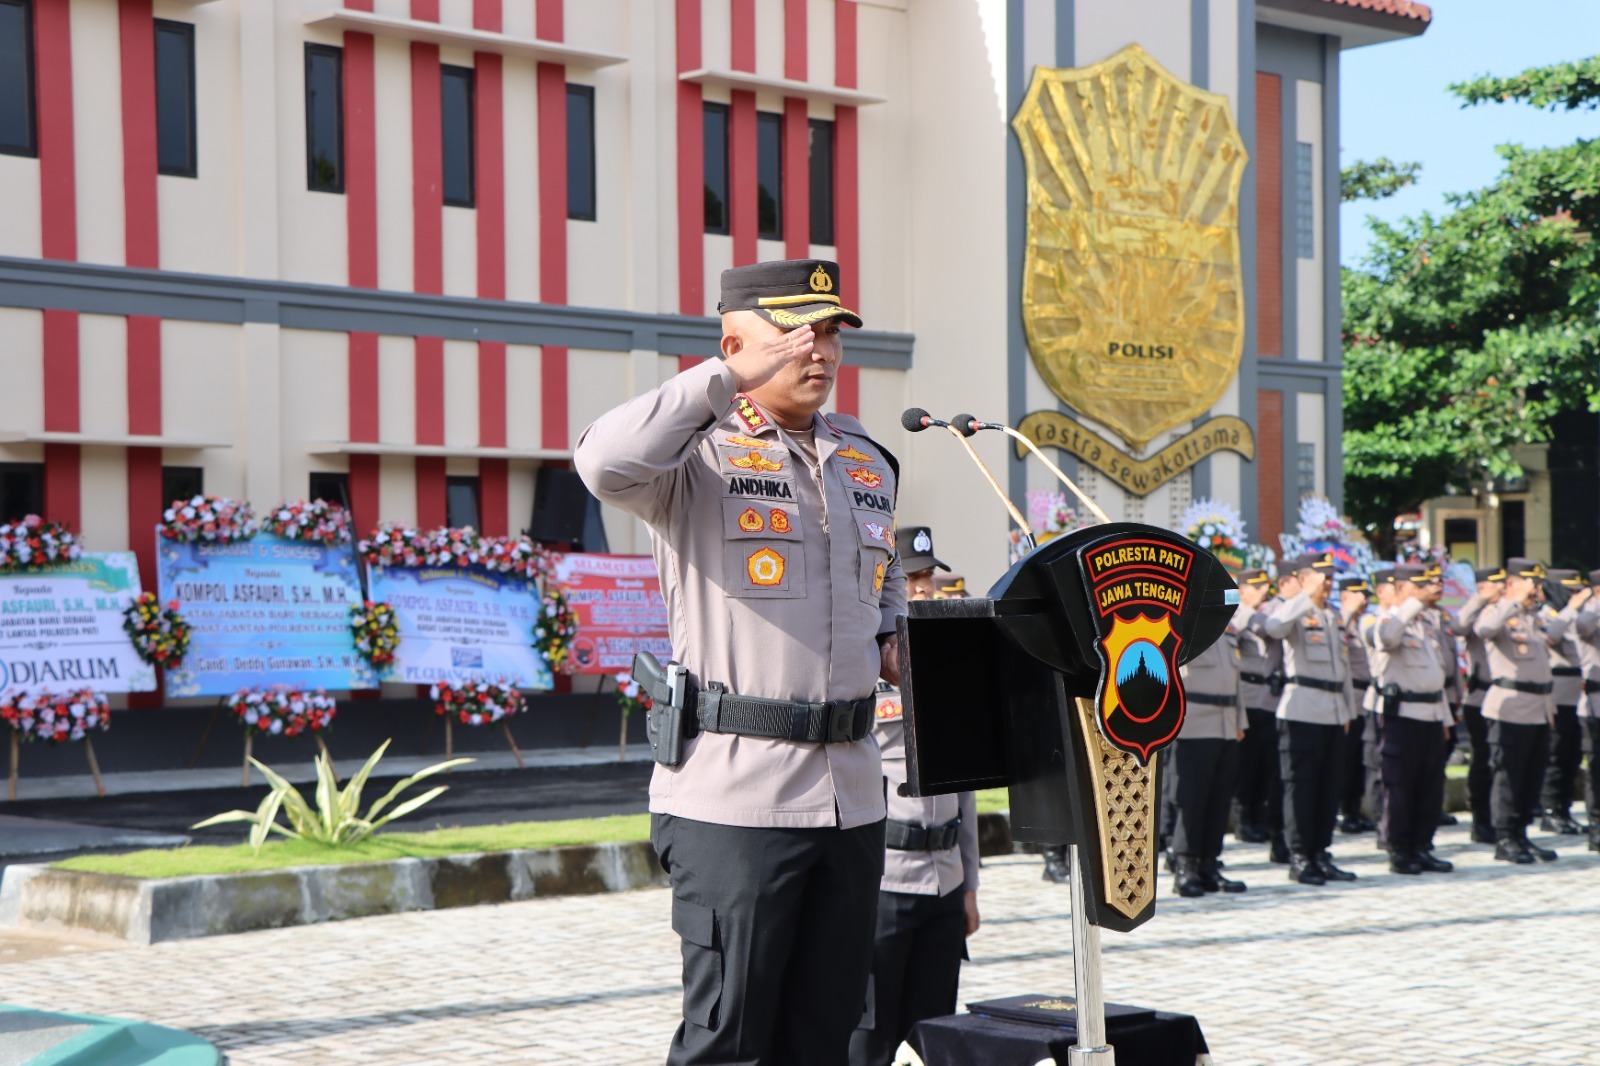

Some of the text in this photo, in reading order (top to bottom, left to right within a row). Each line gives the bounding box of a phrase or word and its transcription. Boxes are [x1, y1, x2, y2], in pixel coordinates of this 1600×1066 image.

[1108, 342, 1174, 359] POLISI
[1035, 423, 1241, 490] rastra sewakottama
[729, 477, 792, 499] ANDHIKA
[853, 491, 892, 514] POLRI
[1095, 547, 1185, 571] POLRESTA PATI
[175, 583, 228, 602] KOMPOL
[1101, 582, 1181, 607] JAWA TENGAH
[10, 657, 119, 685] DJARUM
